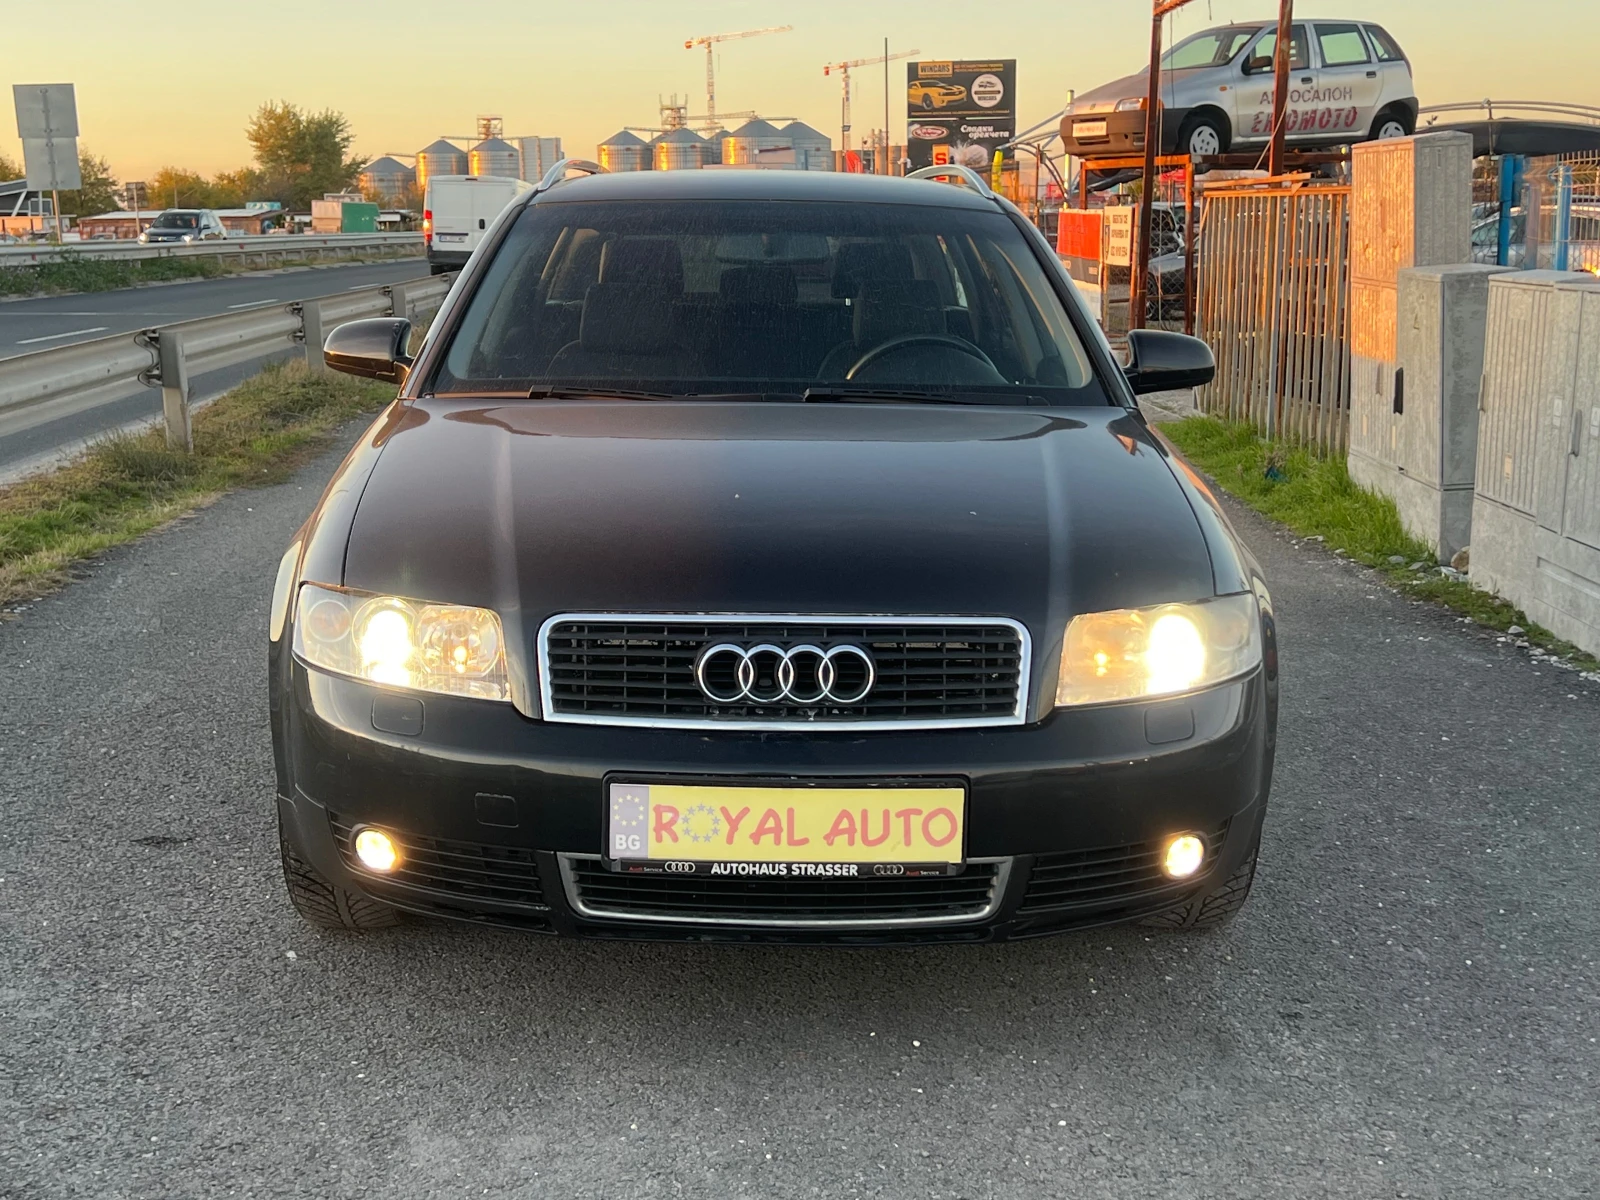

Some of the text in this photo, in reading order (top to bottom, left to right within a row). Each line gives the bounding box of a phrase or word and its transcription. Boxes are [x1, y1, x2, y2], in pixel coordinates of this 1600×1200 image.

[920, 64, 950, 73] WINCARS
[1260, 87, 1352, 104] АОСАЛОН
[960, 124, 994, 133] Сладки
[968, 131, 1010, 139] орехчета
[823, 807, 958, 847] AUTO
[615, 834, 641, 850] BG
[711, 863, 858, 876] AUTOHAUS STRASSER
